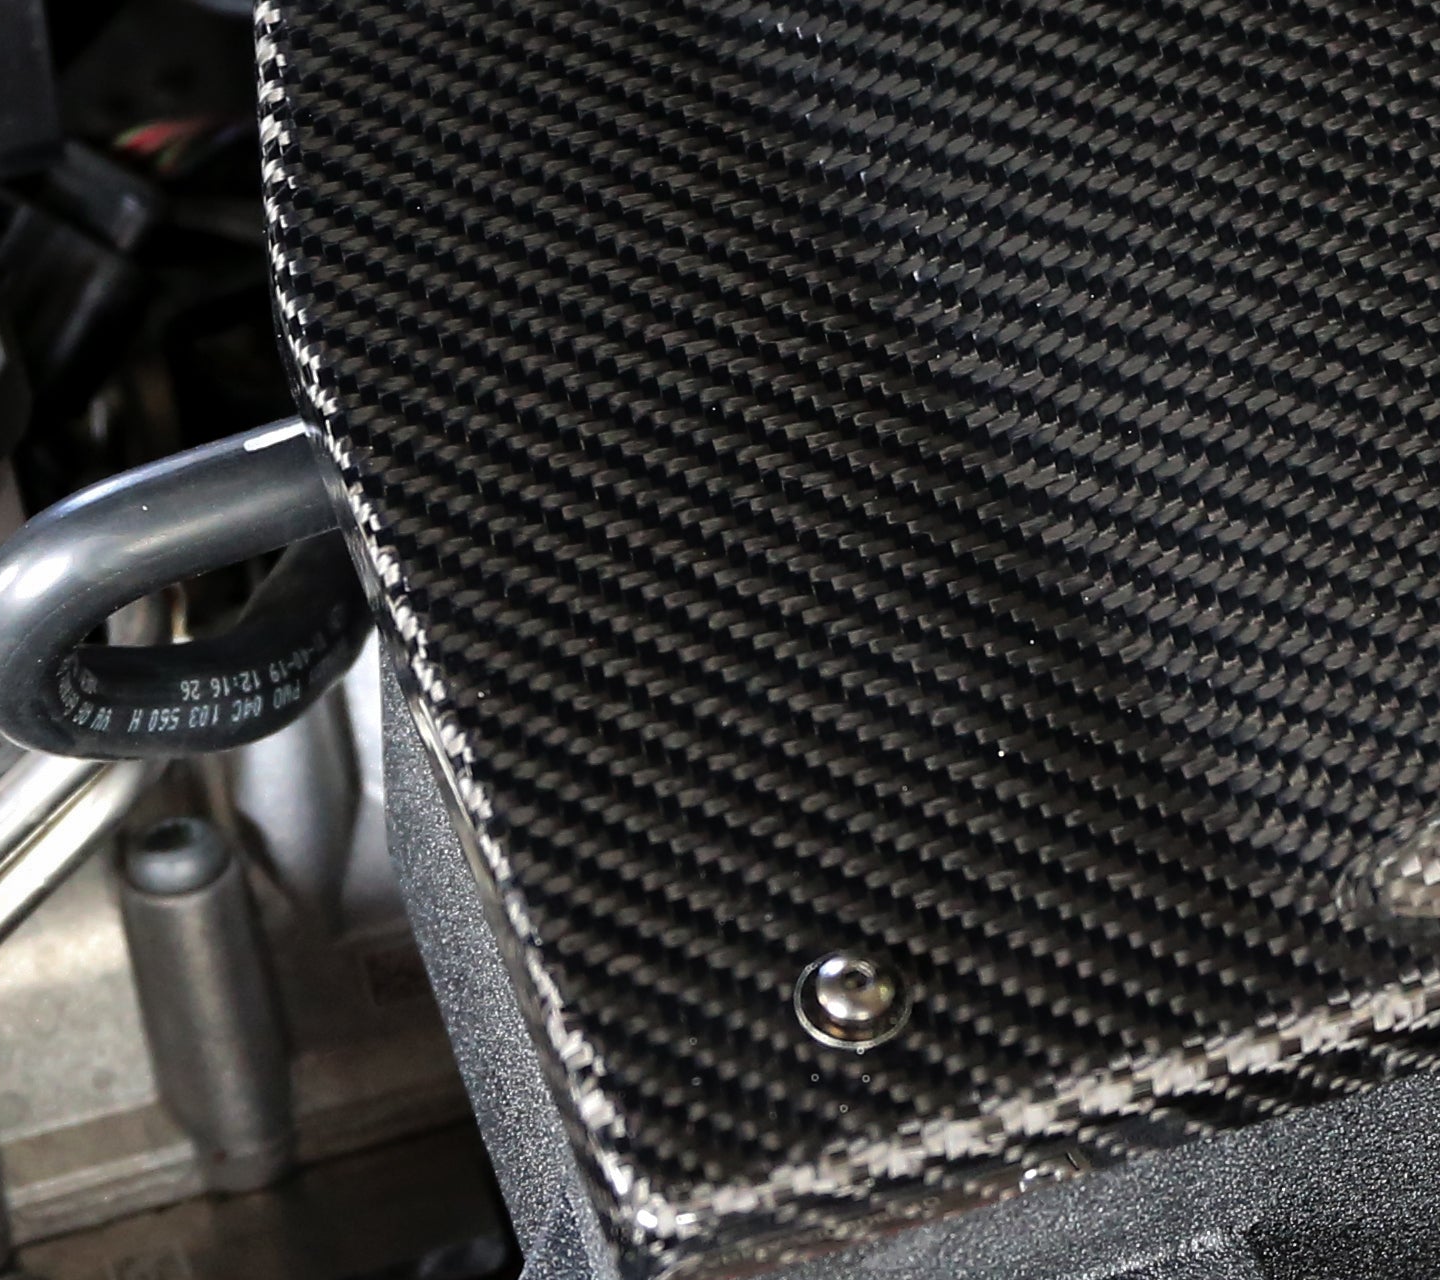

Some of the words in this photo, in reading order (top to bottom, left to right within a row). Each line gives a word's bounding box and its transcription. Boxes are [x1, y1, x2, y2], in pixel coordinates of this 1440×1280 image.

[210, 671, 262, 699] 12:16
[128, 710, 142, 733] H
[189, 704, 219, 729] 103
[231, 695, 262, 722] 04C
